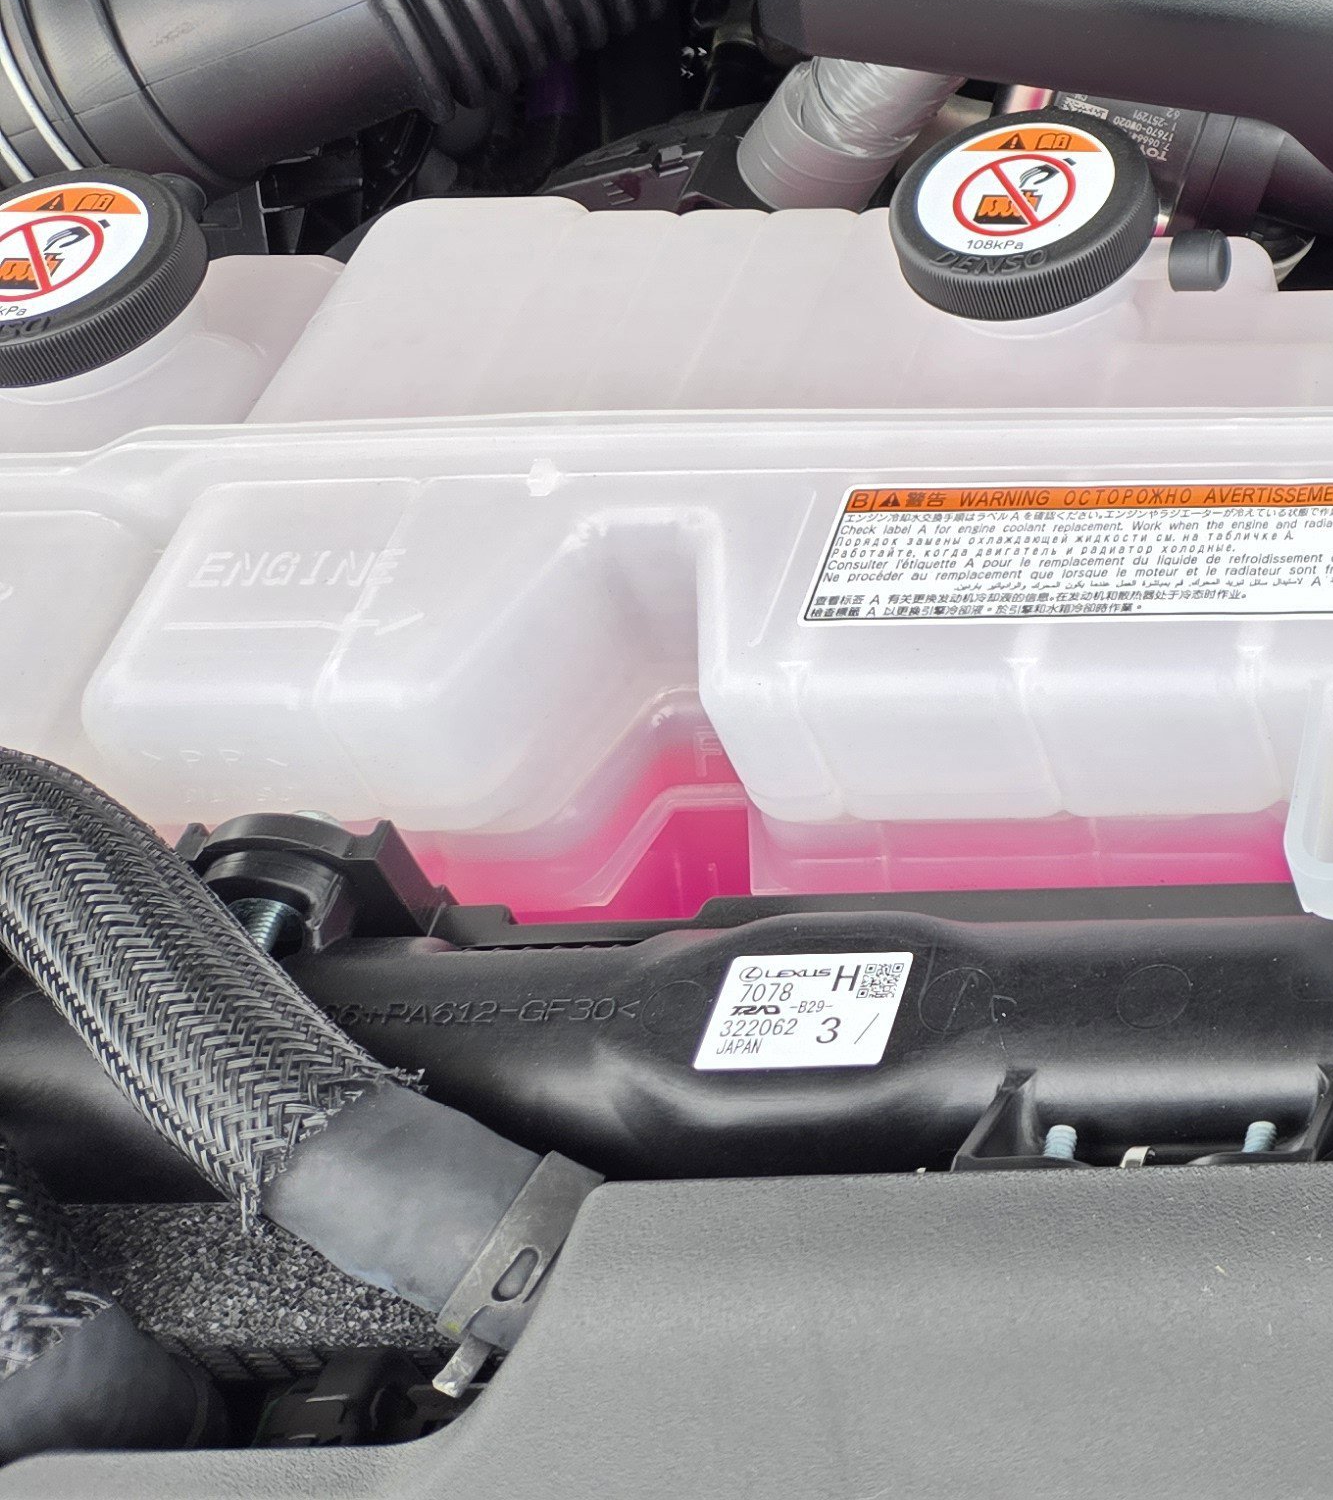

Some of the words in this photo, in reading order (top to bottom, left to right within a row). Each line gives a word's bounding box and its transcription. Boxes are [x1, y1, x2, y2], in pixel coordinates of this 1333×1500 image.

[966, 239, 1024, 250] 108kPa
[928, 249, 1047, 276] DENSO
[849, 492, 868, 509] B
[904, 491, 945, 507] 警告
[959, 489, 1049, 507] WARNING
[1063, 487, 1191, 506] ОСТОРОЖНО
[839, 524, 876, 535] Check
[882, 524, 912, 534] label
[916, 524, 926, 534] A
[934, 523, 951, 534] for
[957, 523, 995, 534] engine
[1002, 522, 1046, 533] coolant
[1052, 521, 1123, 533] replacement.
[1131, 520, 1162, 531] Work
[1168, 520, 1199, 530] when
[1206, 519, 1224, 530] the
[1230, 519, 1268, 531] engine
[1275, 518, 1297, 529] and
[187, 548, 407, 588] ENGINE
[827, 559, 888, 570] Consulter
[963, 557, 974, 568] A
[981, 558, 1012, 569] pour
[1019, 556, 1031, 567] le
[1038, 556, 1125, 567] remplacement
[1132, 555, 1149, 565] du
[1156, 554, 1197, 566] liquide
[1205, 553, 1221, 564] de
[1228, 553, 1323, 564] refroidissement
[822, 571, 840, 582] Ne
[846, 570, 904, 583] procéder
[910, 571, 928, 580] au
[934, 569, 1022, 580] remplacement
[1029, 570, 1054, 580] que
[1061, 568, 1108, 578] lorsque
[1115, 567, 1127, 577] le
[1134, 567, 1178, 577] moteur
[1185, 566, 1198, 576] et
[1205, 565, 1217, 576] le
[1224, 565, 1281, 576] radiateur
[1288, 564, 1317, 575] sont
[764, 968, 832, 978] LEXUS
[831, 964, 861, 992] H
[740, 982, 794, 1002] 7078
[789, 1000, 834, 1014] -B29-
[719, 1018, 798, 1037] 322062
[815, 1016, 841, 1044] 3
[716, 1038, 763, 1055] JAPAN
